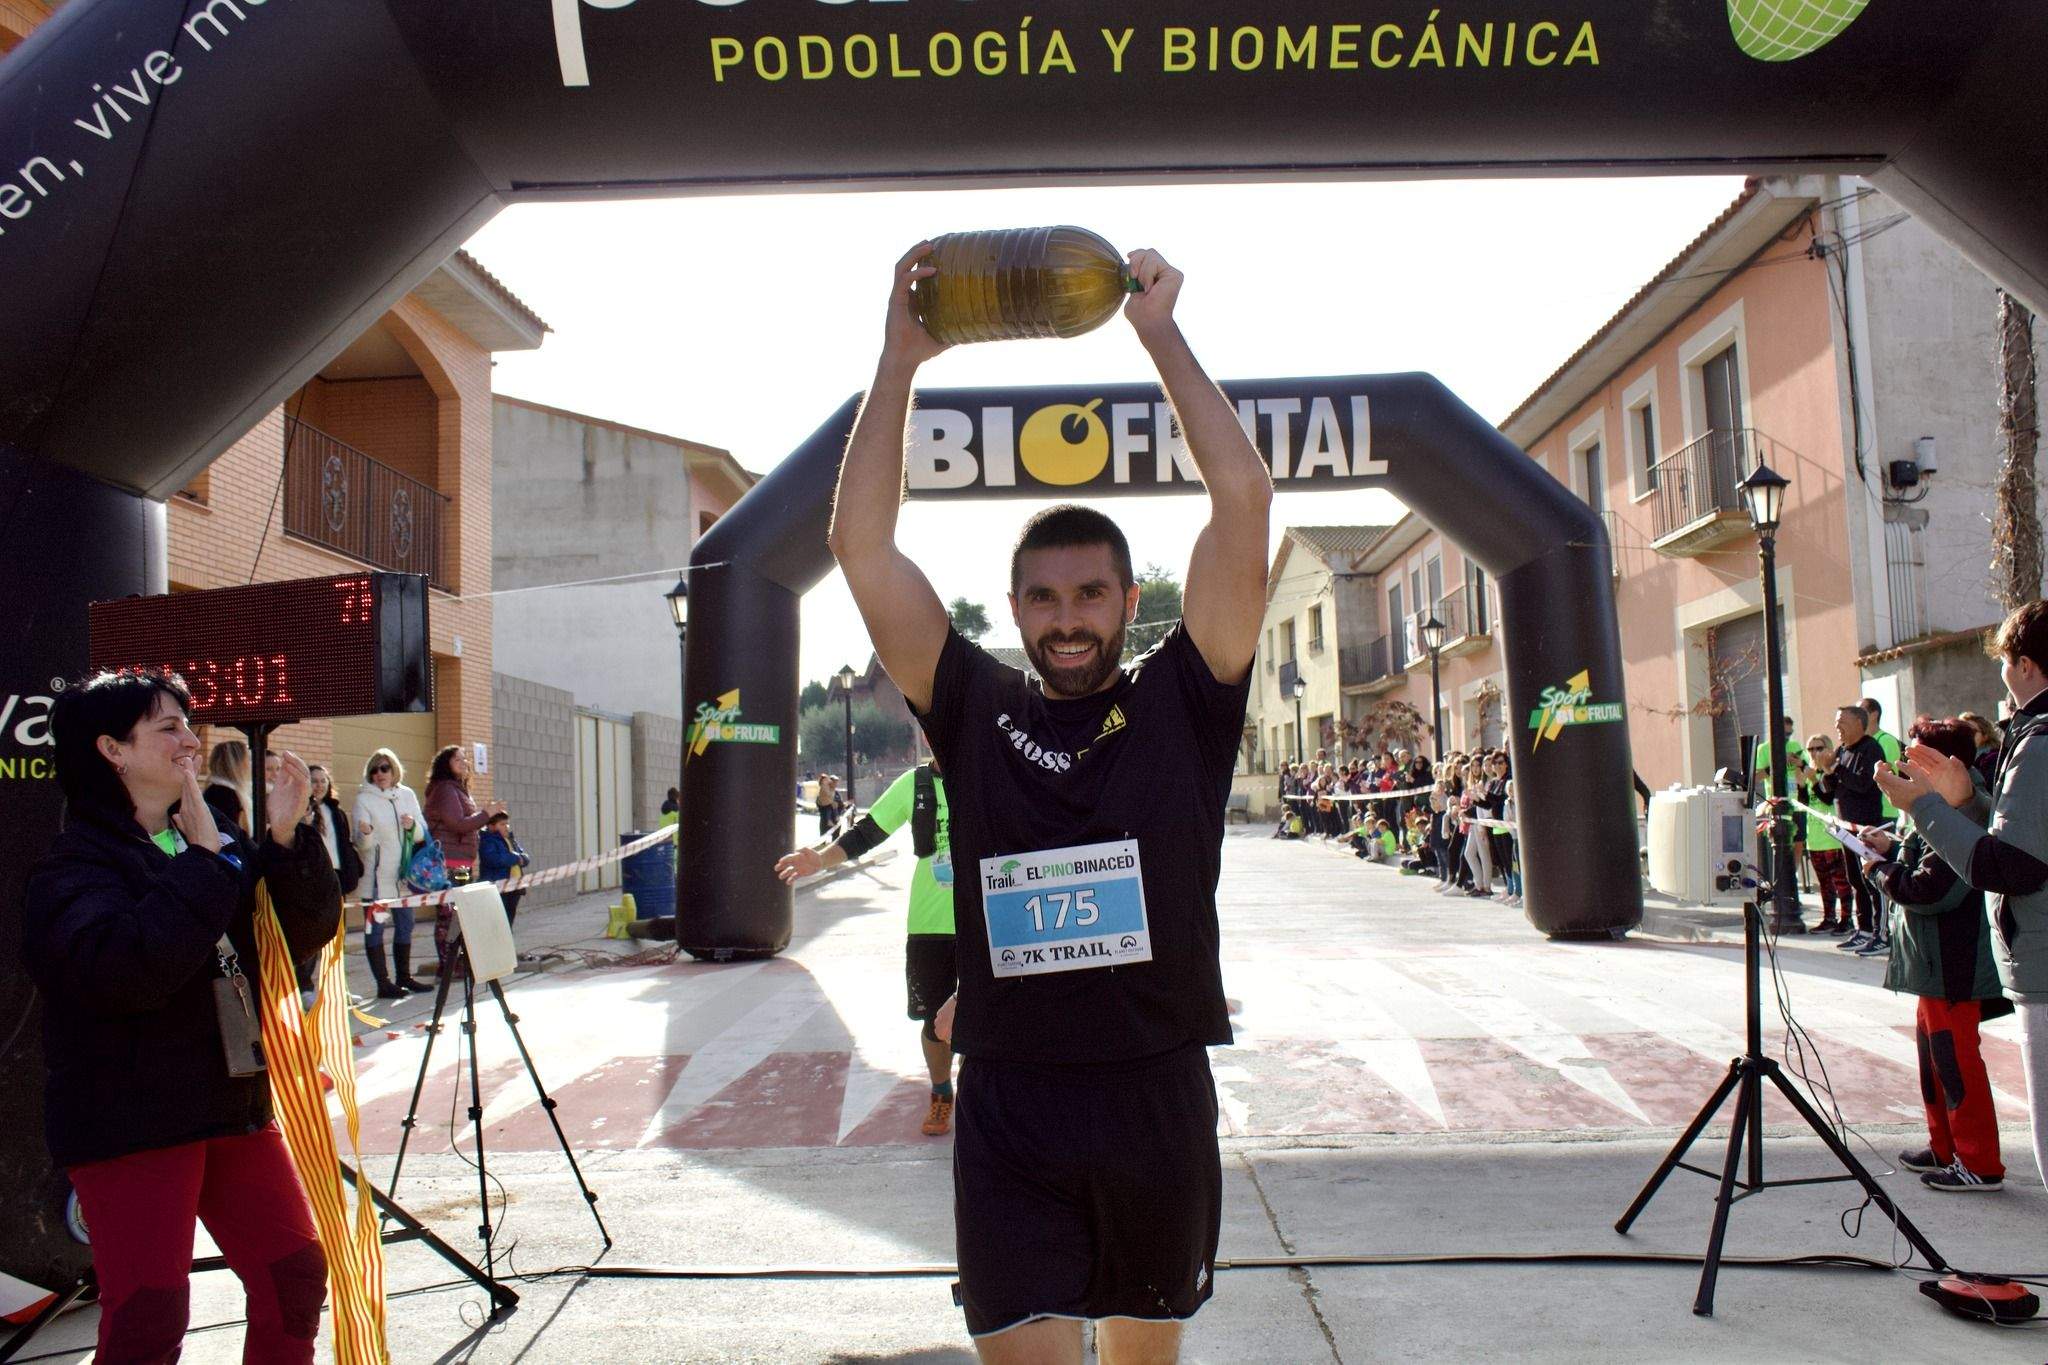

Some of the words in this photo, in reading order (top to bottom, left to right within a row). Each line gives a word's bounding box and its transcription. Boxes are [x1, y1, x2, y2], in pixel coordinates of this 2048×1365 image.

[710, 16, 1077, 83] PODOLOGÍA
[1101, 27, 1136, 73] Y
[1162, 9, 1601, 73] BIOMECÁNICA
[0, 156, 84, 235] en,
[73, 50, 183, 140] vive
[907, 395, 1389, 490] BIOFRTAL
[694, 701, 742, 730] Sport
[1538, 685, 1593, 714] Sport
[986, 873, 1013, 890] Trail
[1023, 888, 1100, 934] 175
[1022, 949, 1046, 964] 7K
[1049, 941, 1112, 962] TRAIL
